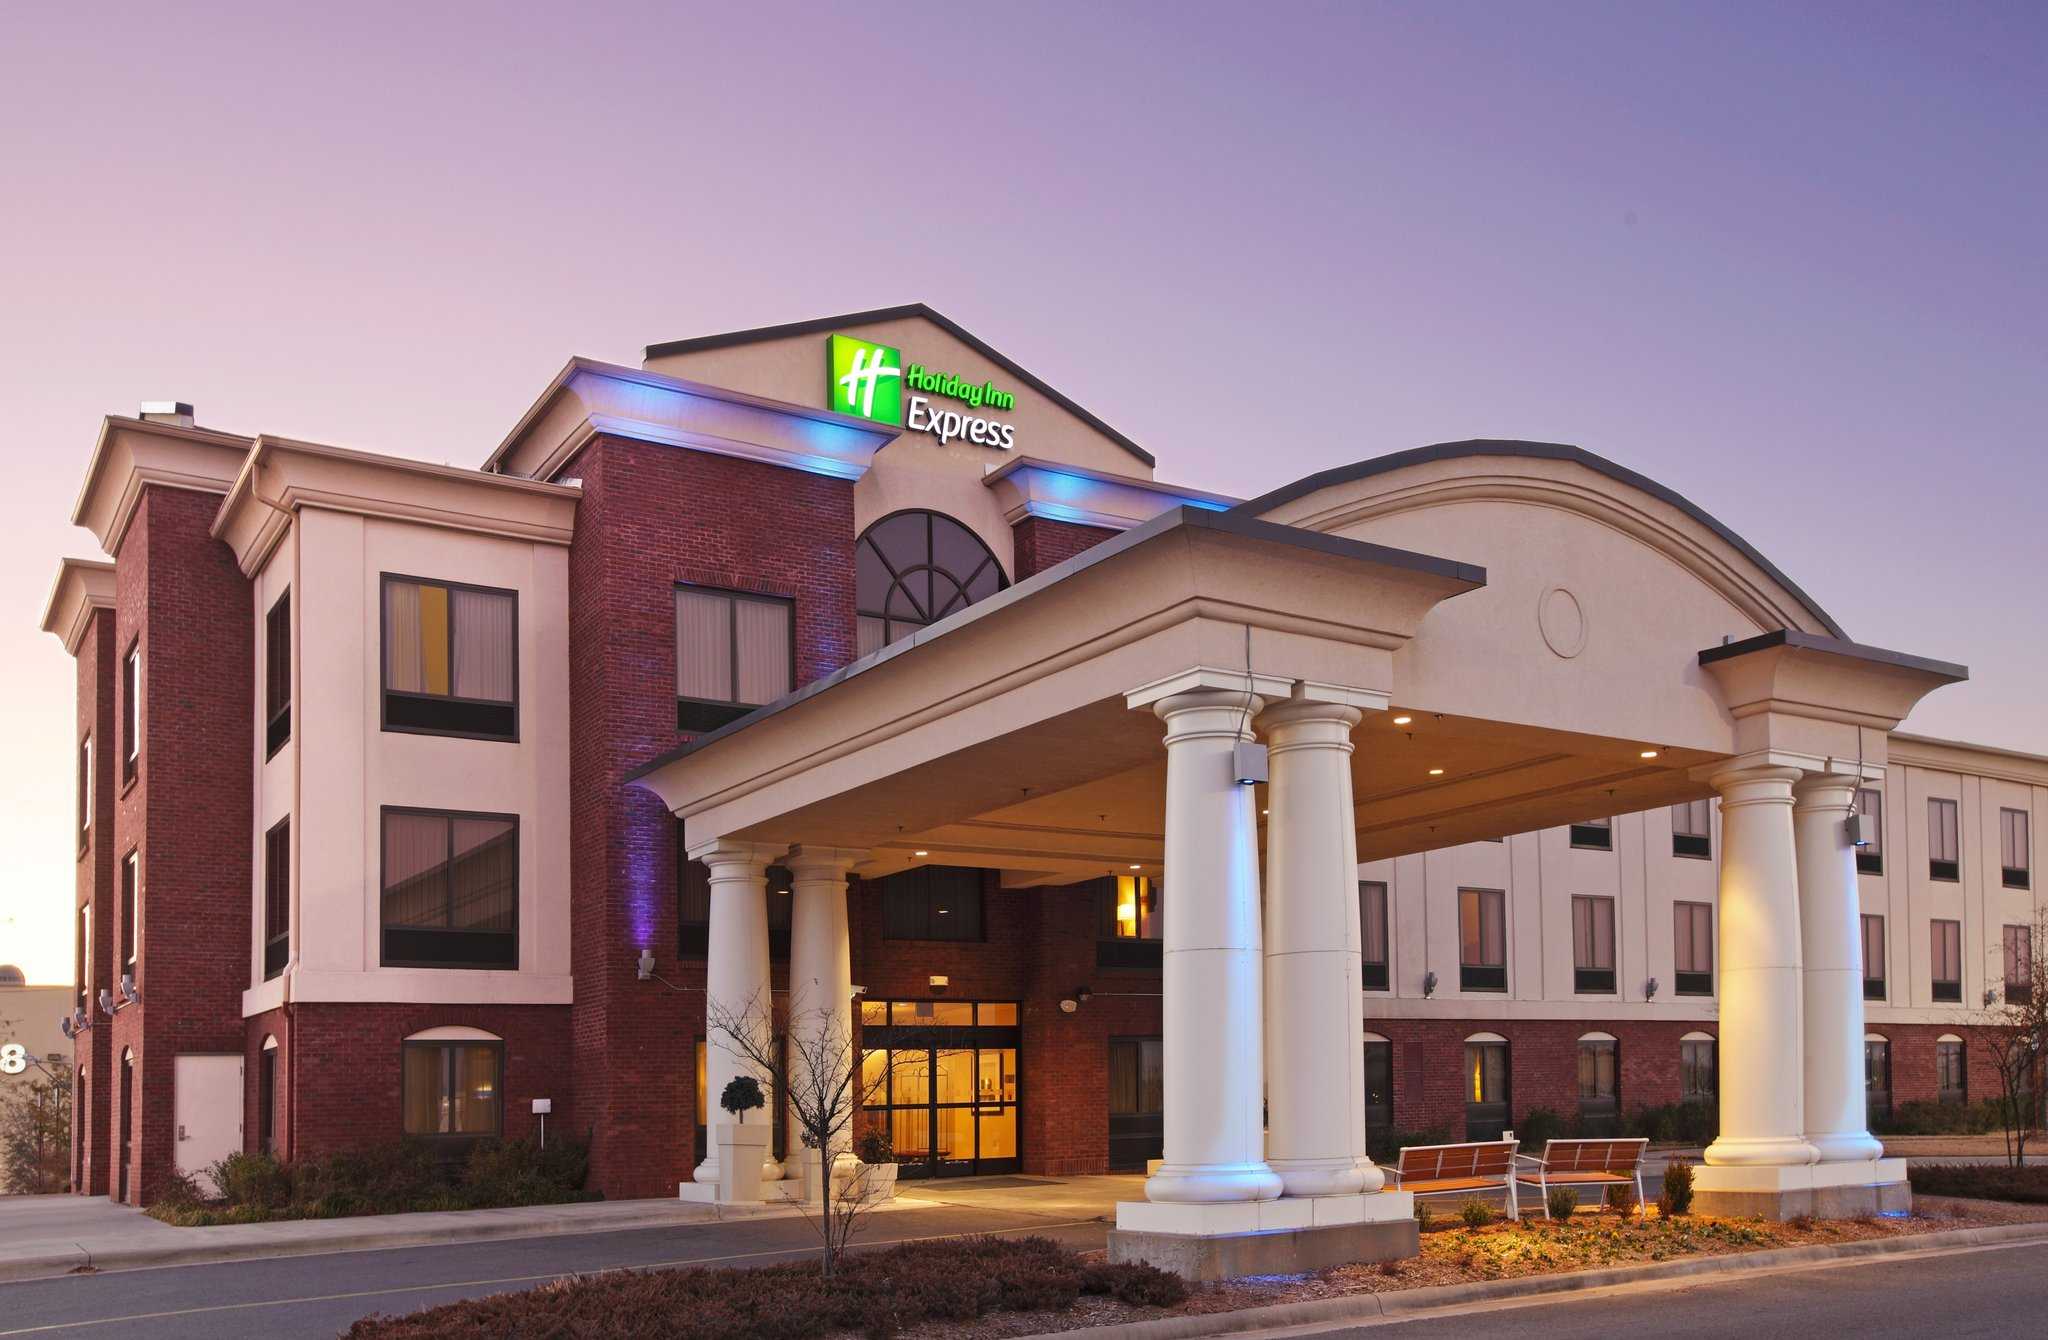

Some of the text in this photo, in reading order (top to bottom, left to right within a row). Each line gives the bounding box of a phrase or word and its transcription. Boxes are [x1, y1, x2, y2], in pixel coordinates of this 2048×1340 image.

[907, 364, 1014, 409] Holiday Inn
[907, 396, 1015, 449] Express
[0, 1044, 26, 1074] 8
